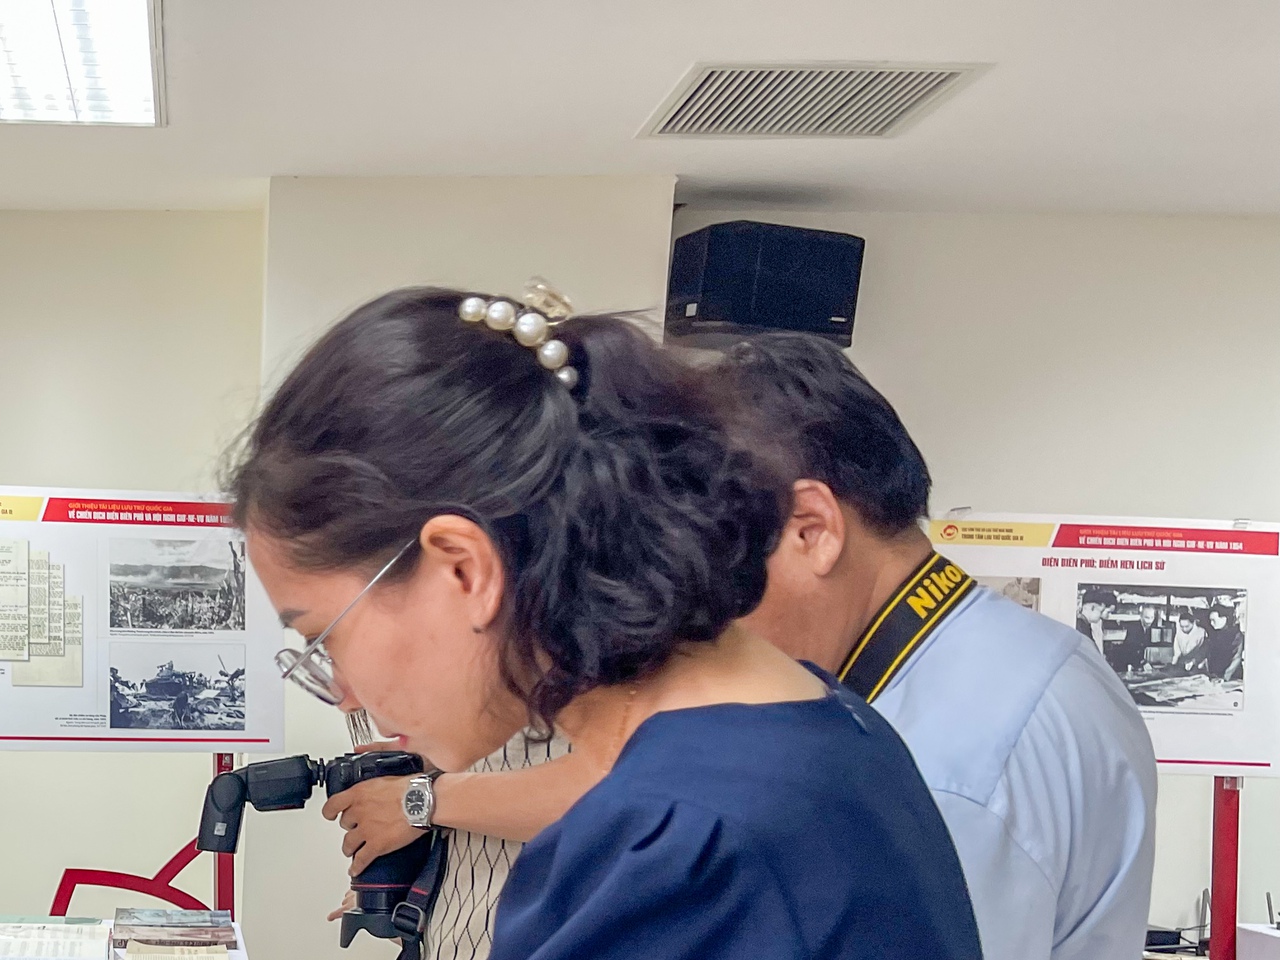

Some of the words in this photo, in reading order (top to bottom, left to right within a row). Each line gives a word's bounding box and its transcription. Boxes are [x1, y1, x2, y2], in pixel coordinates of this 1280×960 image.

[1229, 542, 1243, 550] 1954
[1041, 557, 1059, 568] ĐIỆN
[1060, 557, 1078, 568] BIÊN
[1080, 557, 1097, 569] PHỦ:
[1099, 557, 1118, 569] ĐIỂM
[1120, 560, 1134, 570] HẸN
[1136, 561, 1153, 570] LỊCH
[1155, 560, 1166, 570] SỬ
[906, 563, 964, 619] Niko
